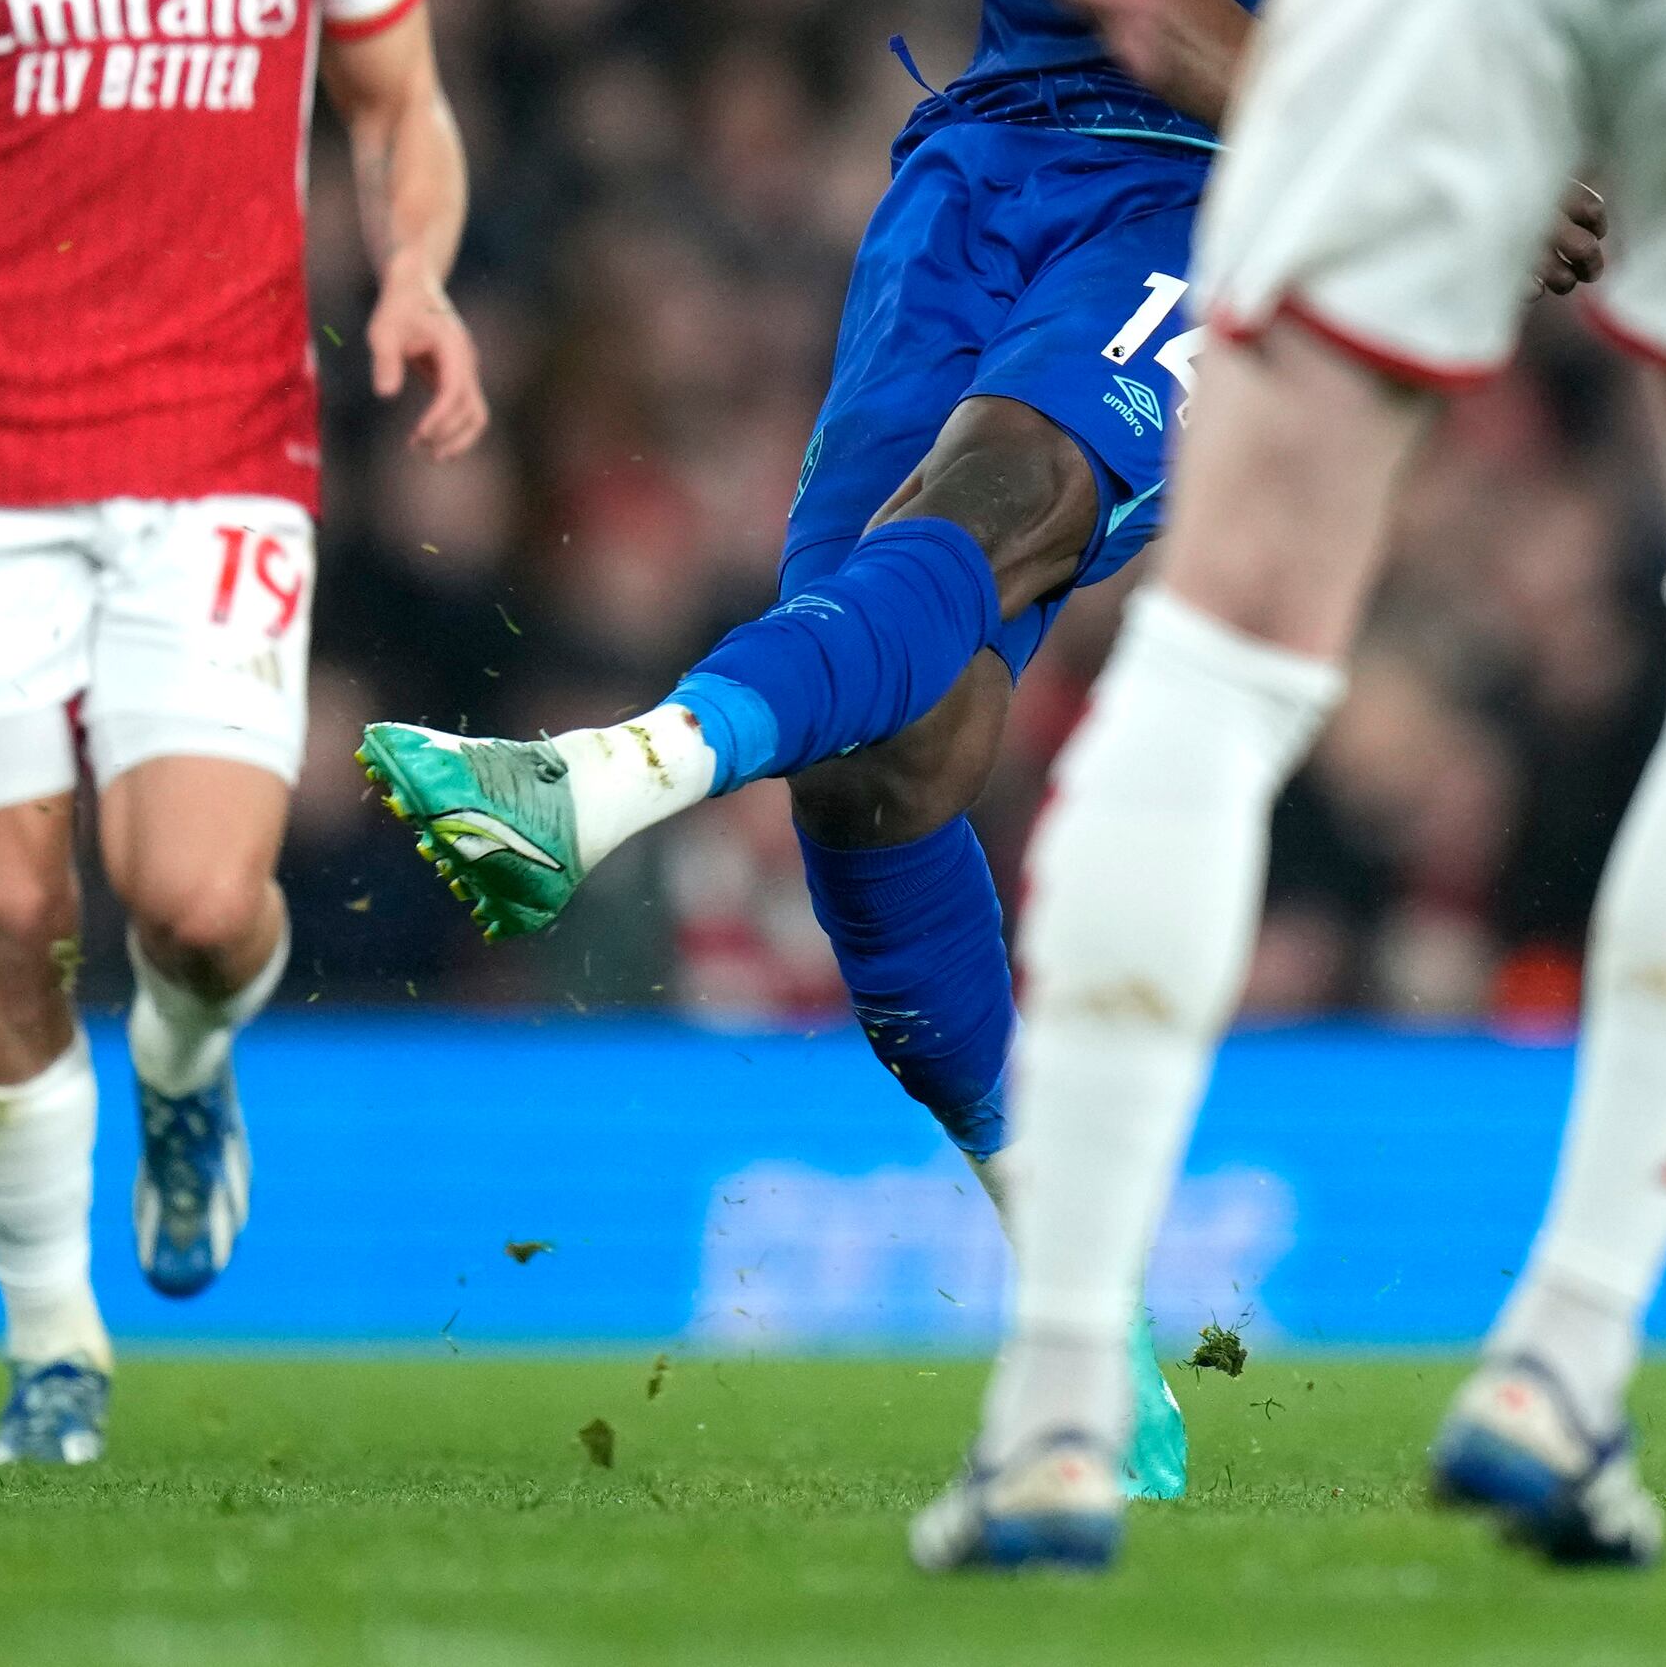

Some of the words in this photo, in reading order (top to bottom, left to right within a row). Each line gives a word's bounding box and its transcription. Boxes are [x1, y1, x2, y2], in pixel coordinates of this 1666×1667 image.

[13, 45, 98, 117] FLY
[98, 44, 262, 113] BETTER
[1102, 391, 1145, 437] umbro
[208, 525, 304, 640] 19
